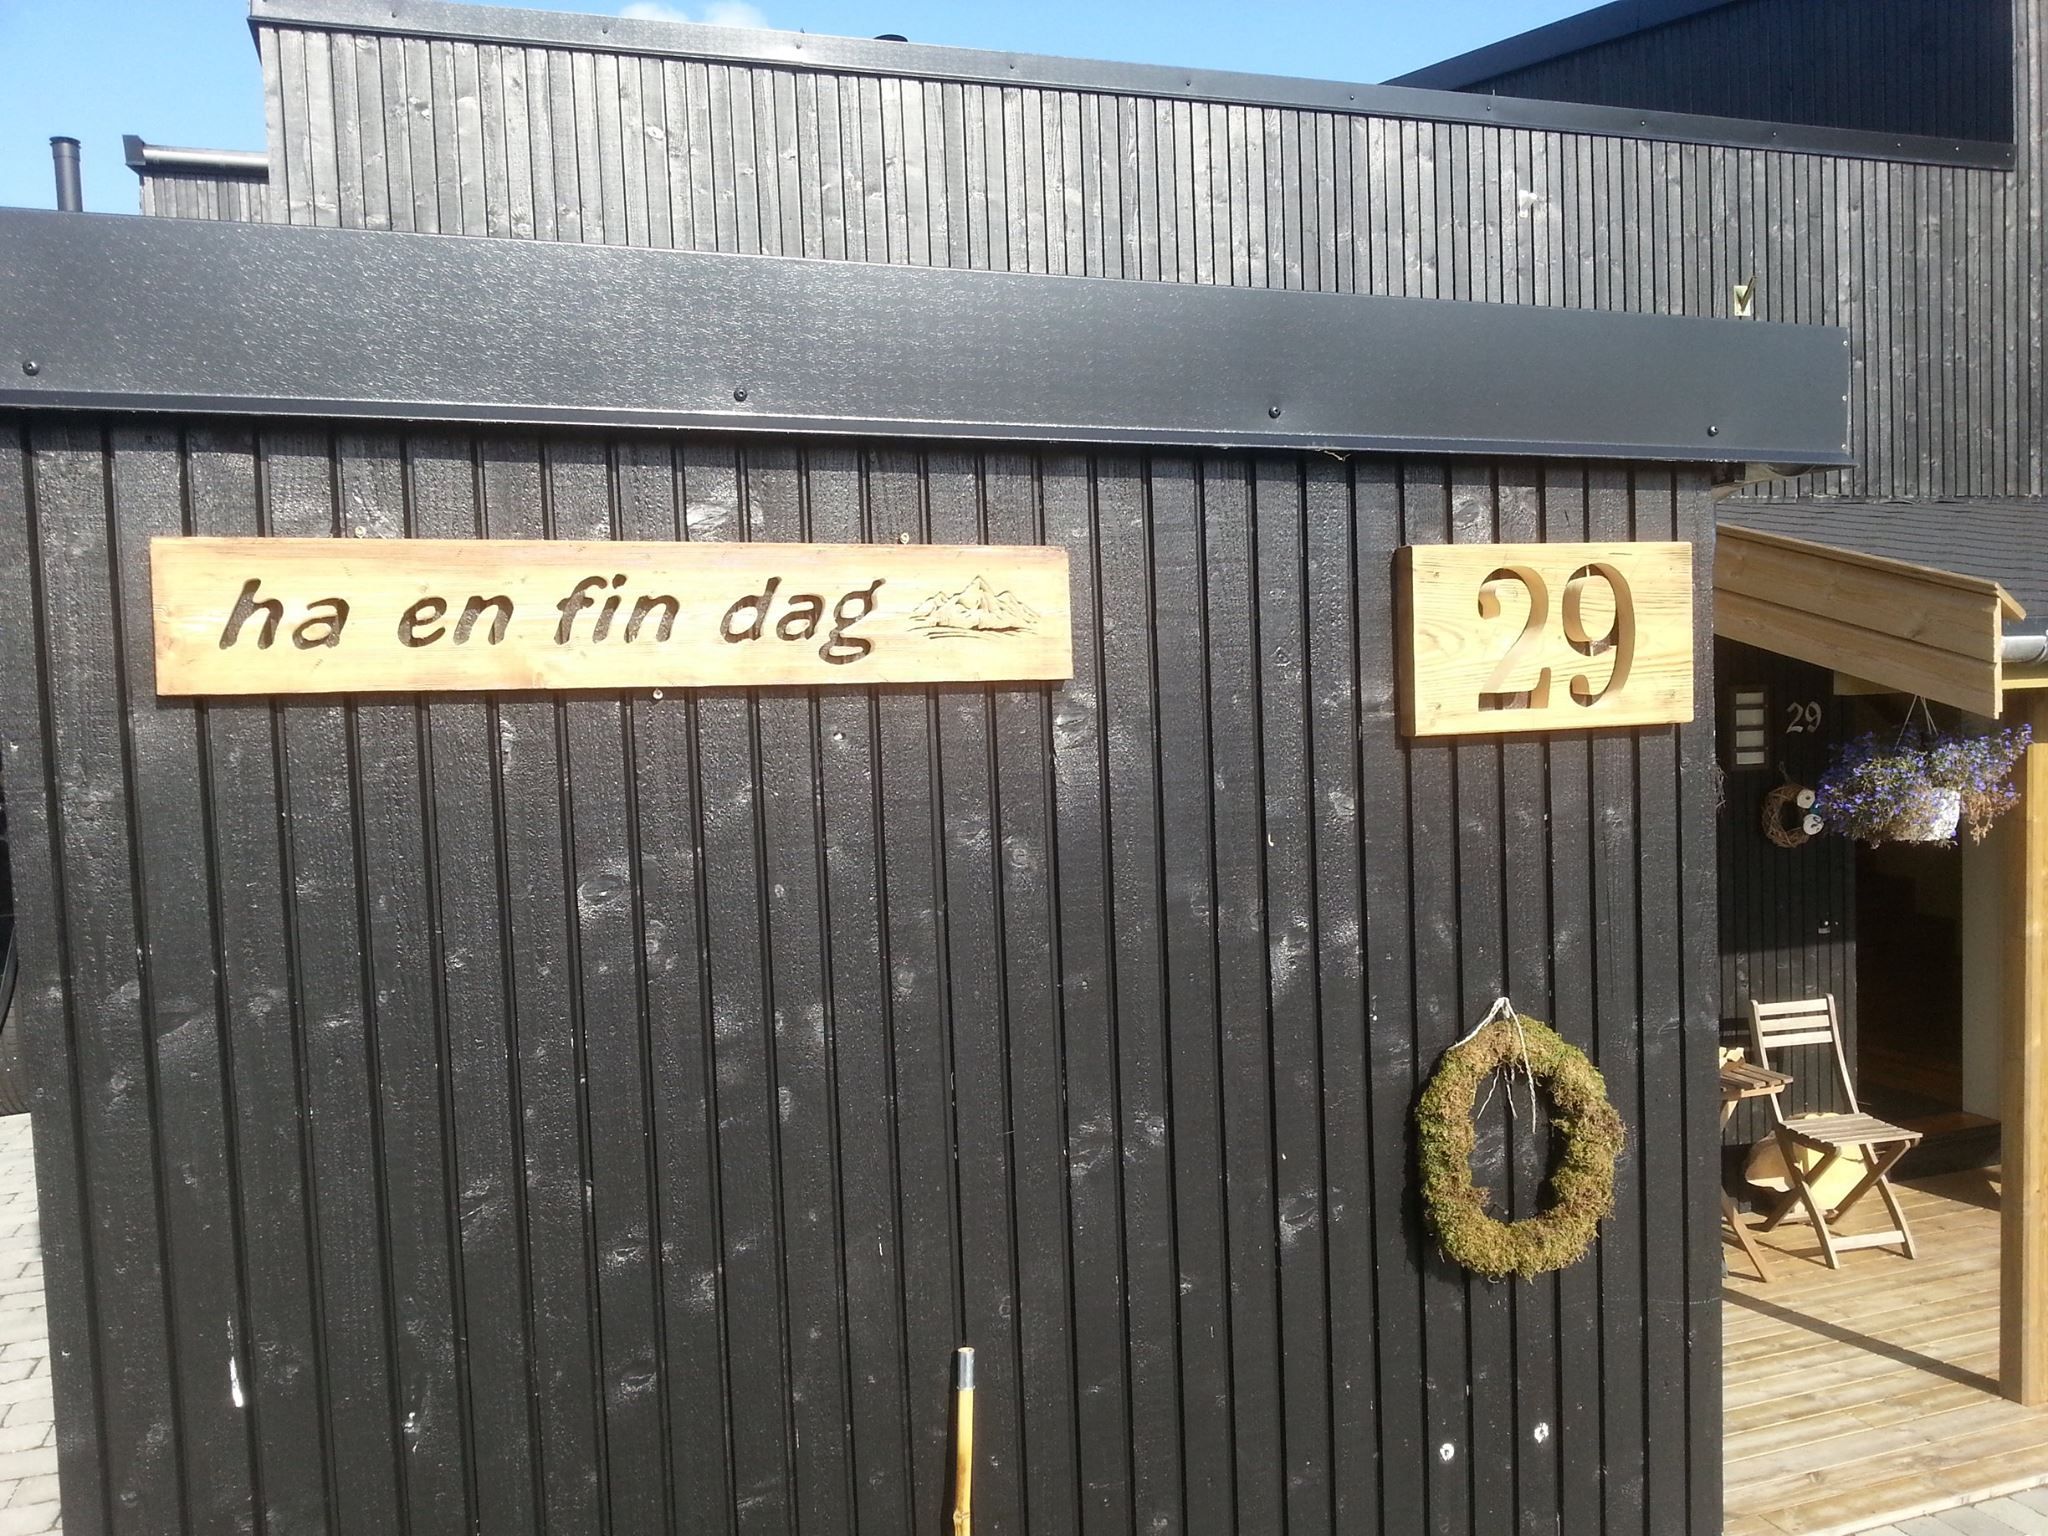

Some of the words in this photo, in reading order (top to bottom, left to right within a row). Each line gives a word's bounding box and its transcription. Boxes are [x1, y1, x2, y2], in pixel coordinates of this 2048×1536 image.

[218, 577, 351, 650] ha
[397, 594, 515, 648] en
[553, 573, 681, 645] fin
[718, 575, 887, 666] dag
[1477, 562, 1636, 712] 29
[1785, 700, 1823, 734] 29
